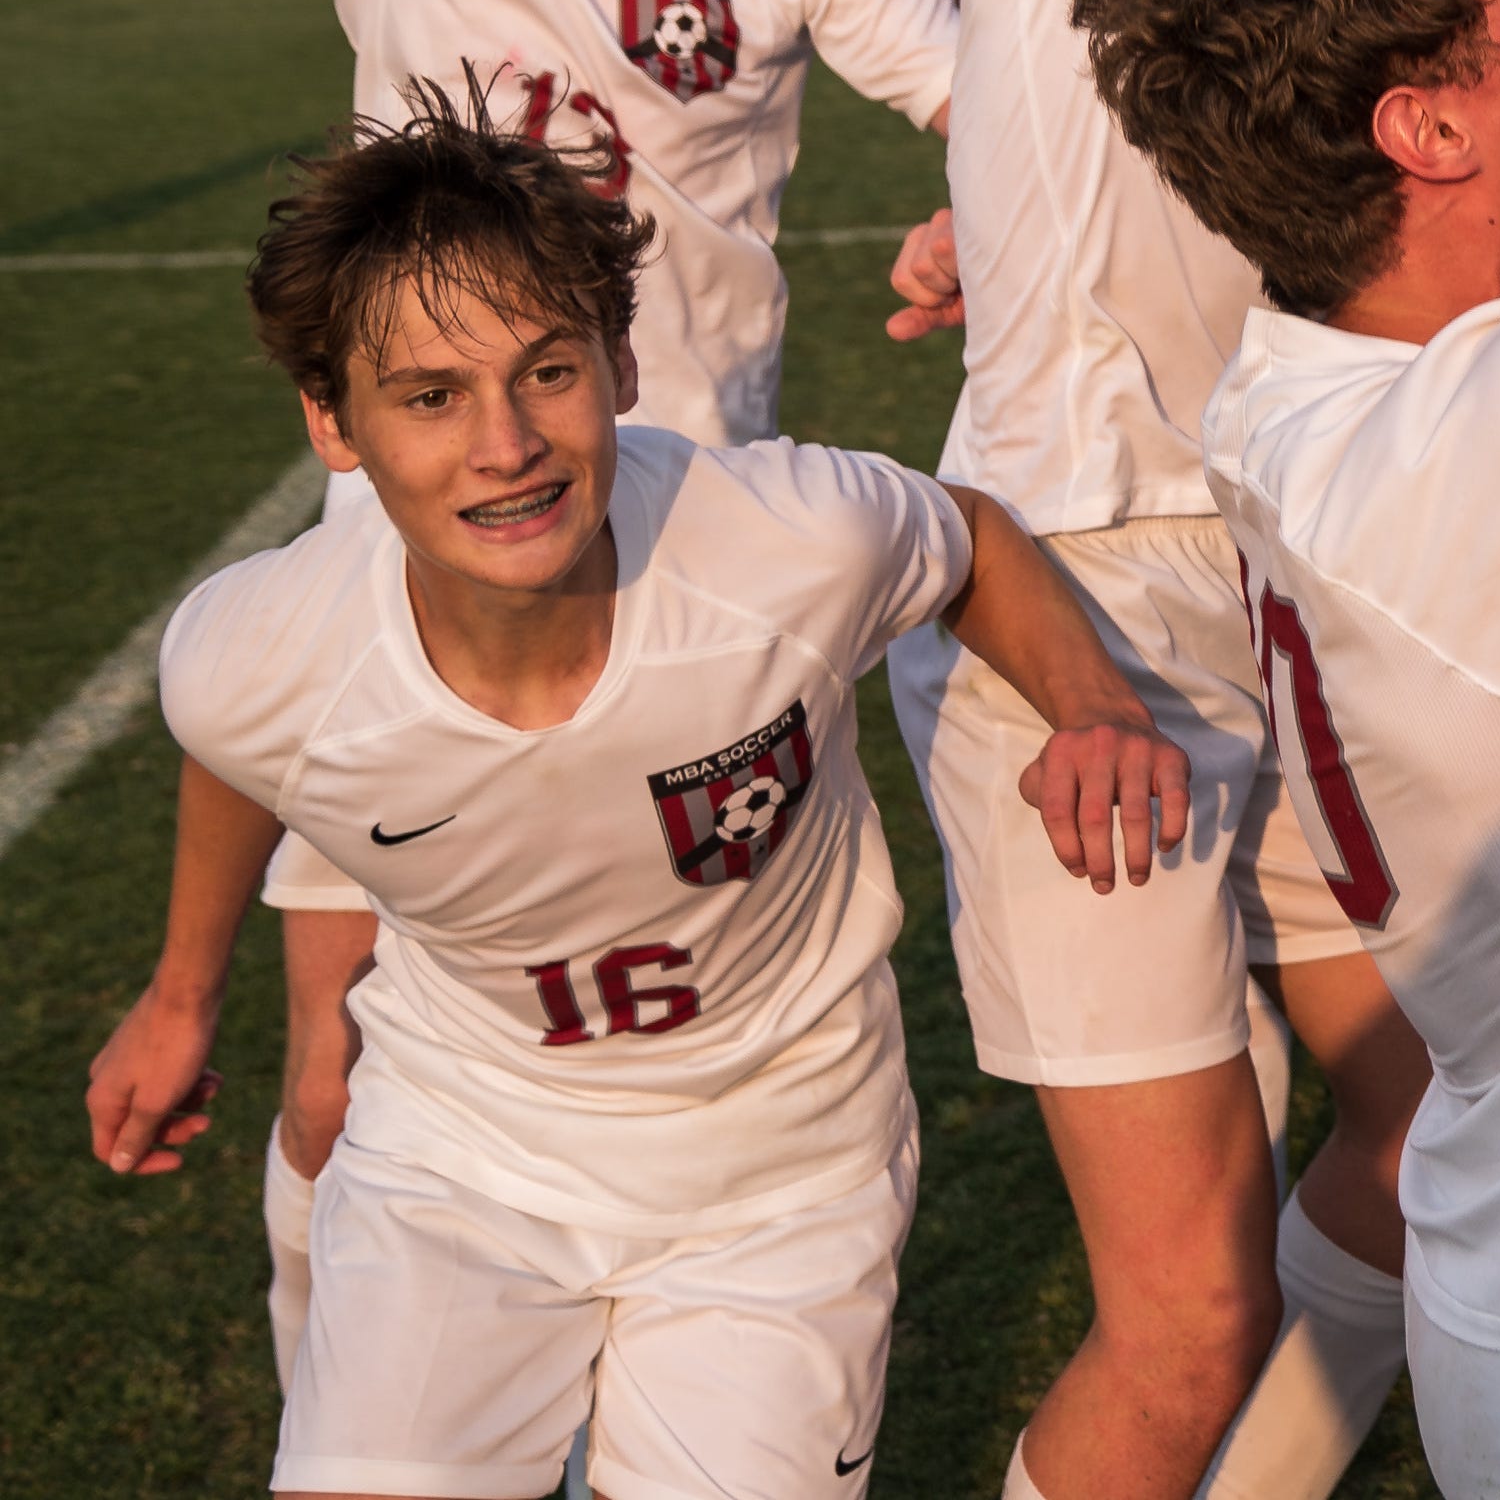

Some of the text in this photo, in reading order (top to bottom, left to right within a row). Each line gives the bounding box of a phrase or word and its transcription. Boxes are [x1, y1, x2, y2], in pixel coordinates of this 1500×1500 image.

[665, 711, 793, 786] MBA SOCCER
[524, 941, 702, 1047] 16
